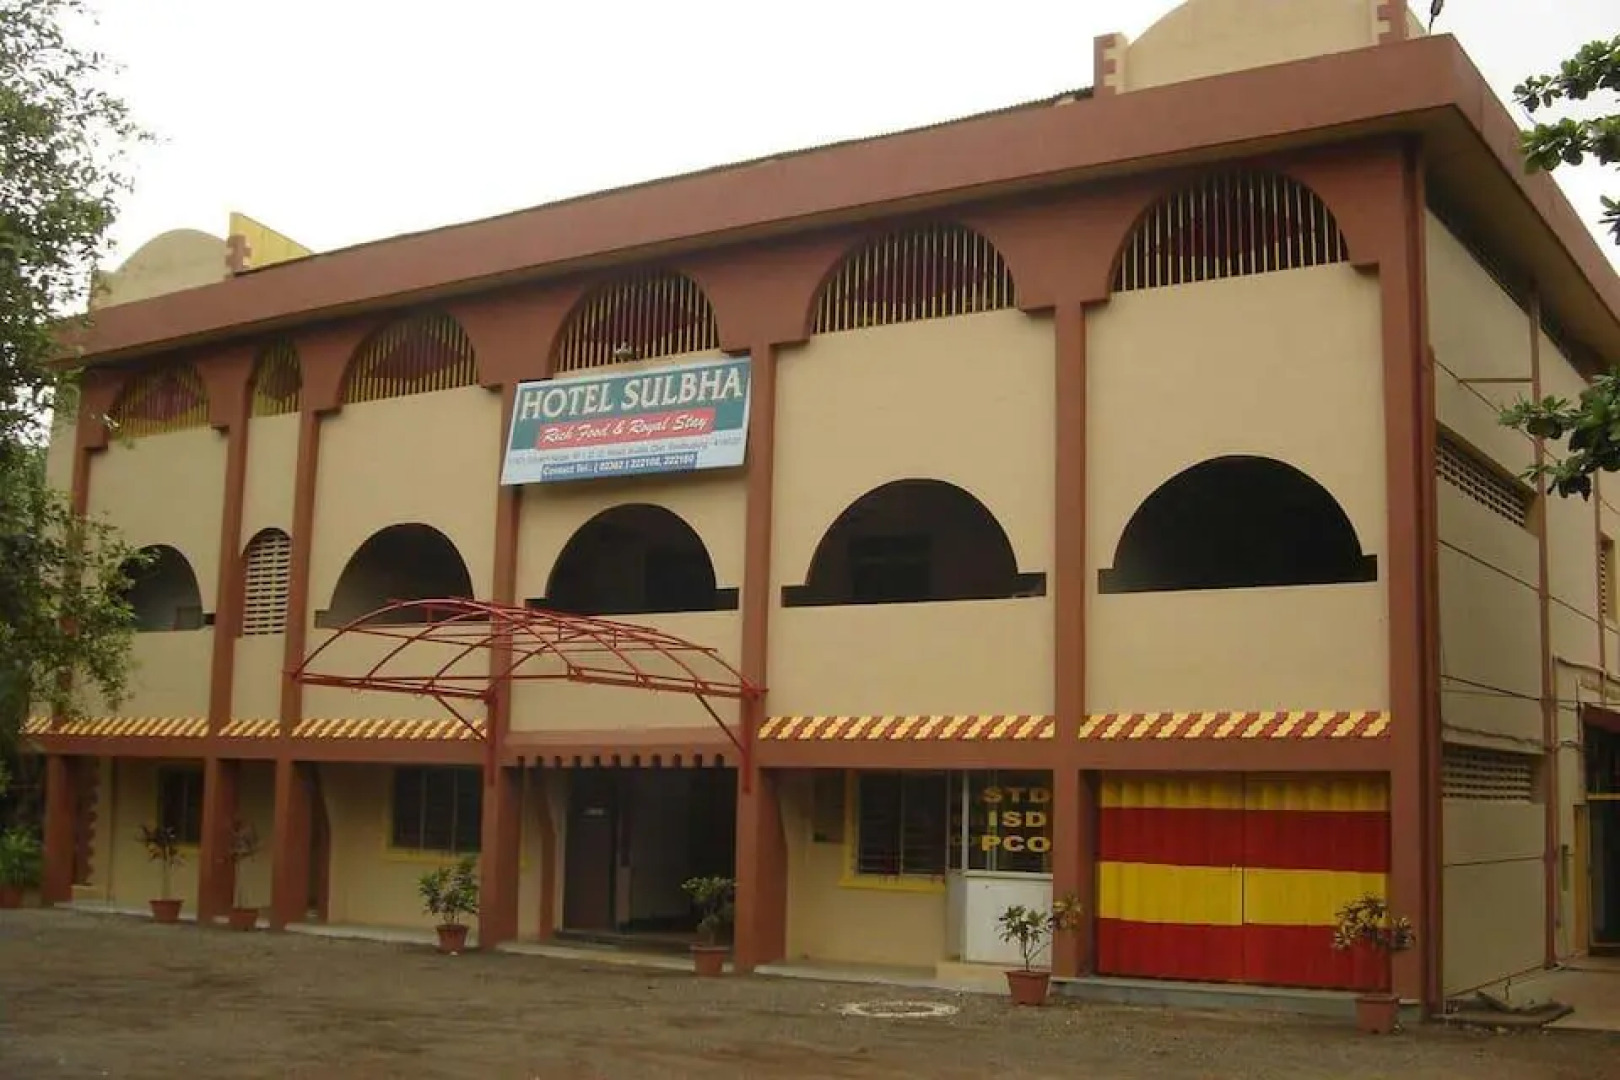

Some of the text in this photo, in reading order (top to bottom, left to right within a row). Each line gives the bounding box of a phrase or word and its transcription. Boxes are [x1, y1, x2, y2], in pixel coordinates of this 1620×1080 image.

[521, 367, 743, 420] HOTEL SULBHA
[543, 414, 708, 443] Rich Food & Royal Stay
[983, 786, 1052, 803] STD
[988, 810, 1047, 828] ISD
[981, 835, 1052, 852] PCO
